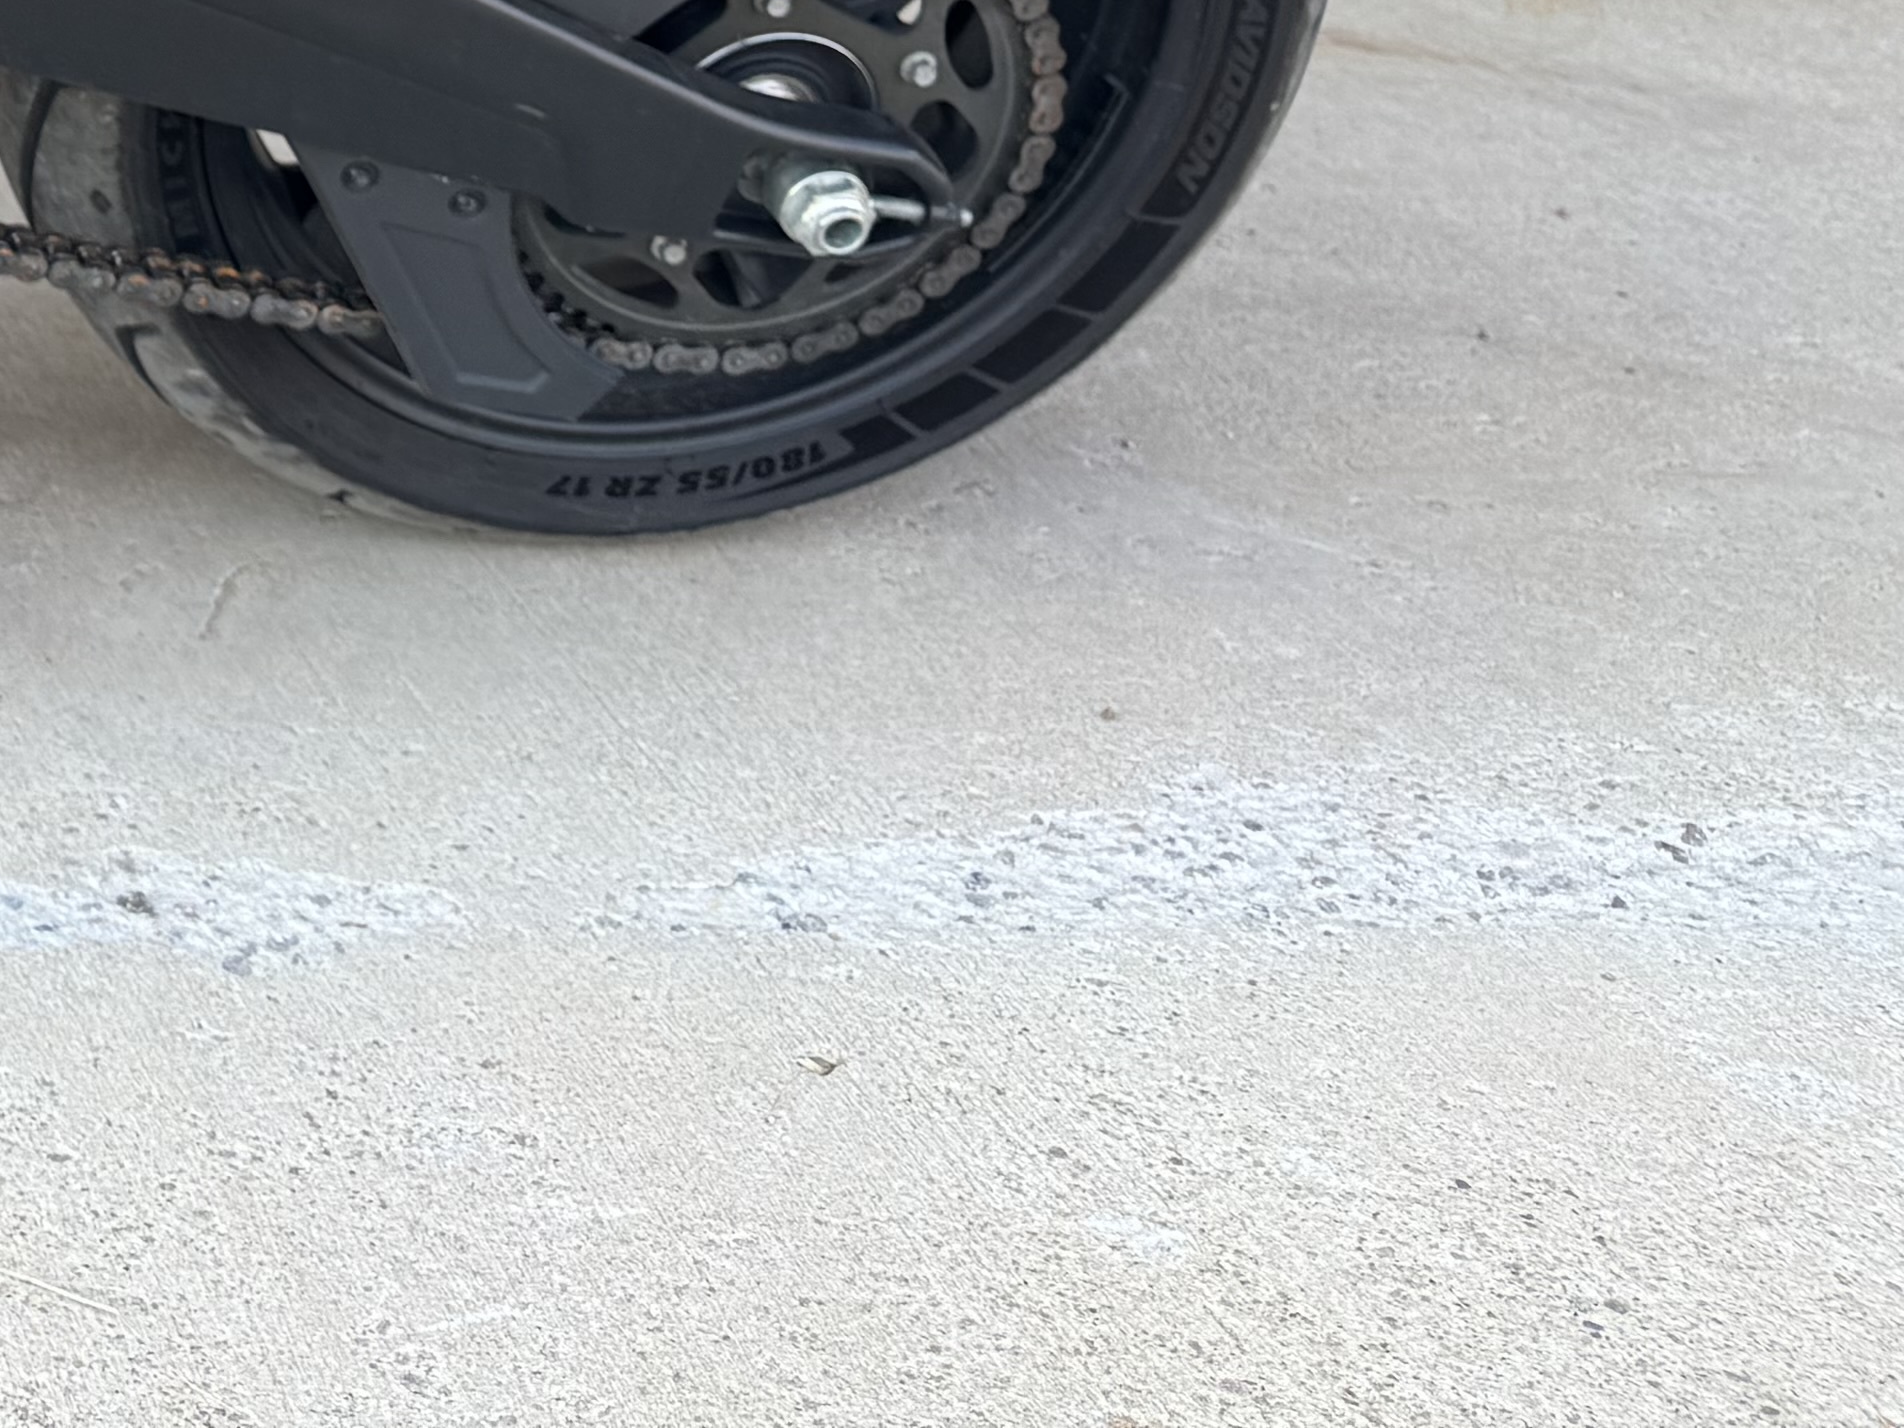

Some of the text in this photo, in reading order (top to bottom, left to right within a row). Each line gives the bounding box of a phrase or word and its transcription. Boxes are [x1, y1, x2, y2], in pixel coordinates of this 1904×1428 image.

[544, 438, 827, 500] 180/55 ZR 17
